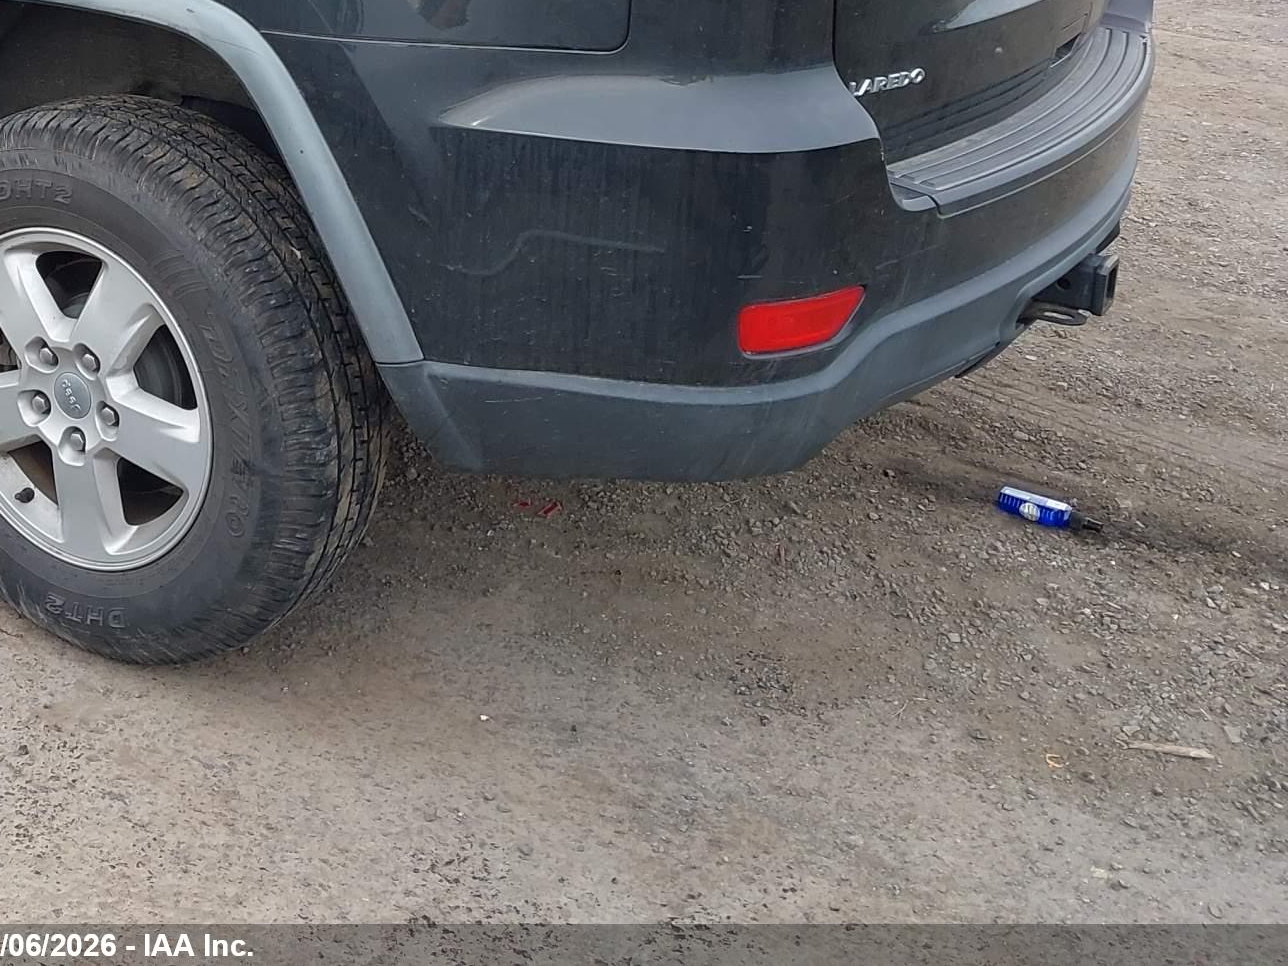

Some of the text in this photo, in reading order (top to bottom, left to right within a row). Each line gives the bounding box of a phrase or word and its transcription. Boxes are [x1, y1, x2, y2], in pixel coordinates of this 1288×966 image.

[849, 67, 926, 96] LAREDO
[61, 377, 83, 412] Jeep
[44, 591, 128, 628] DHT2
